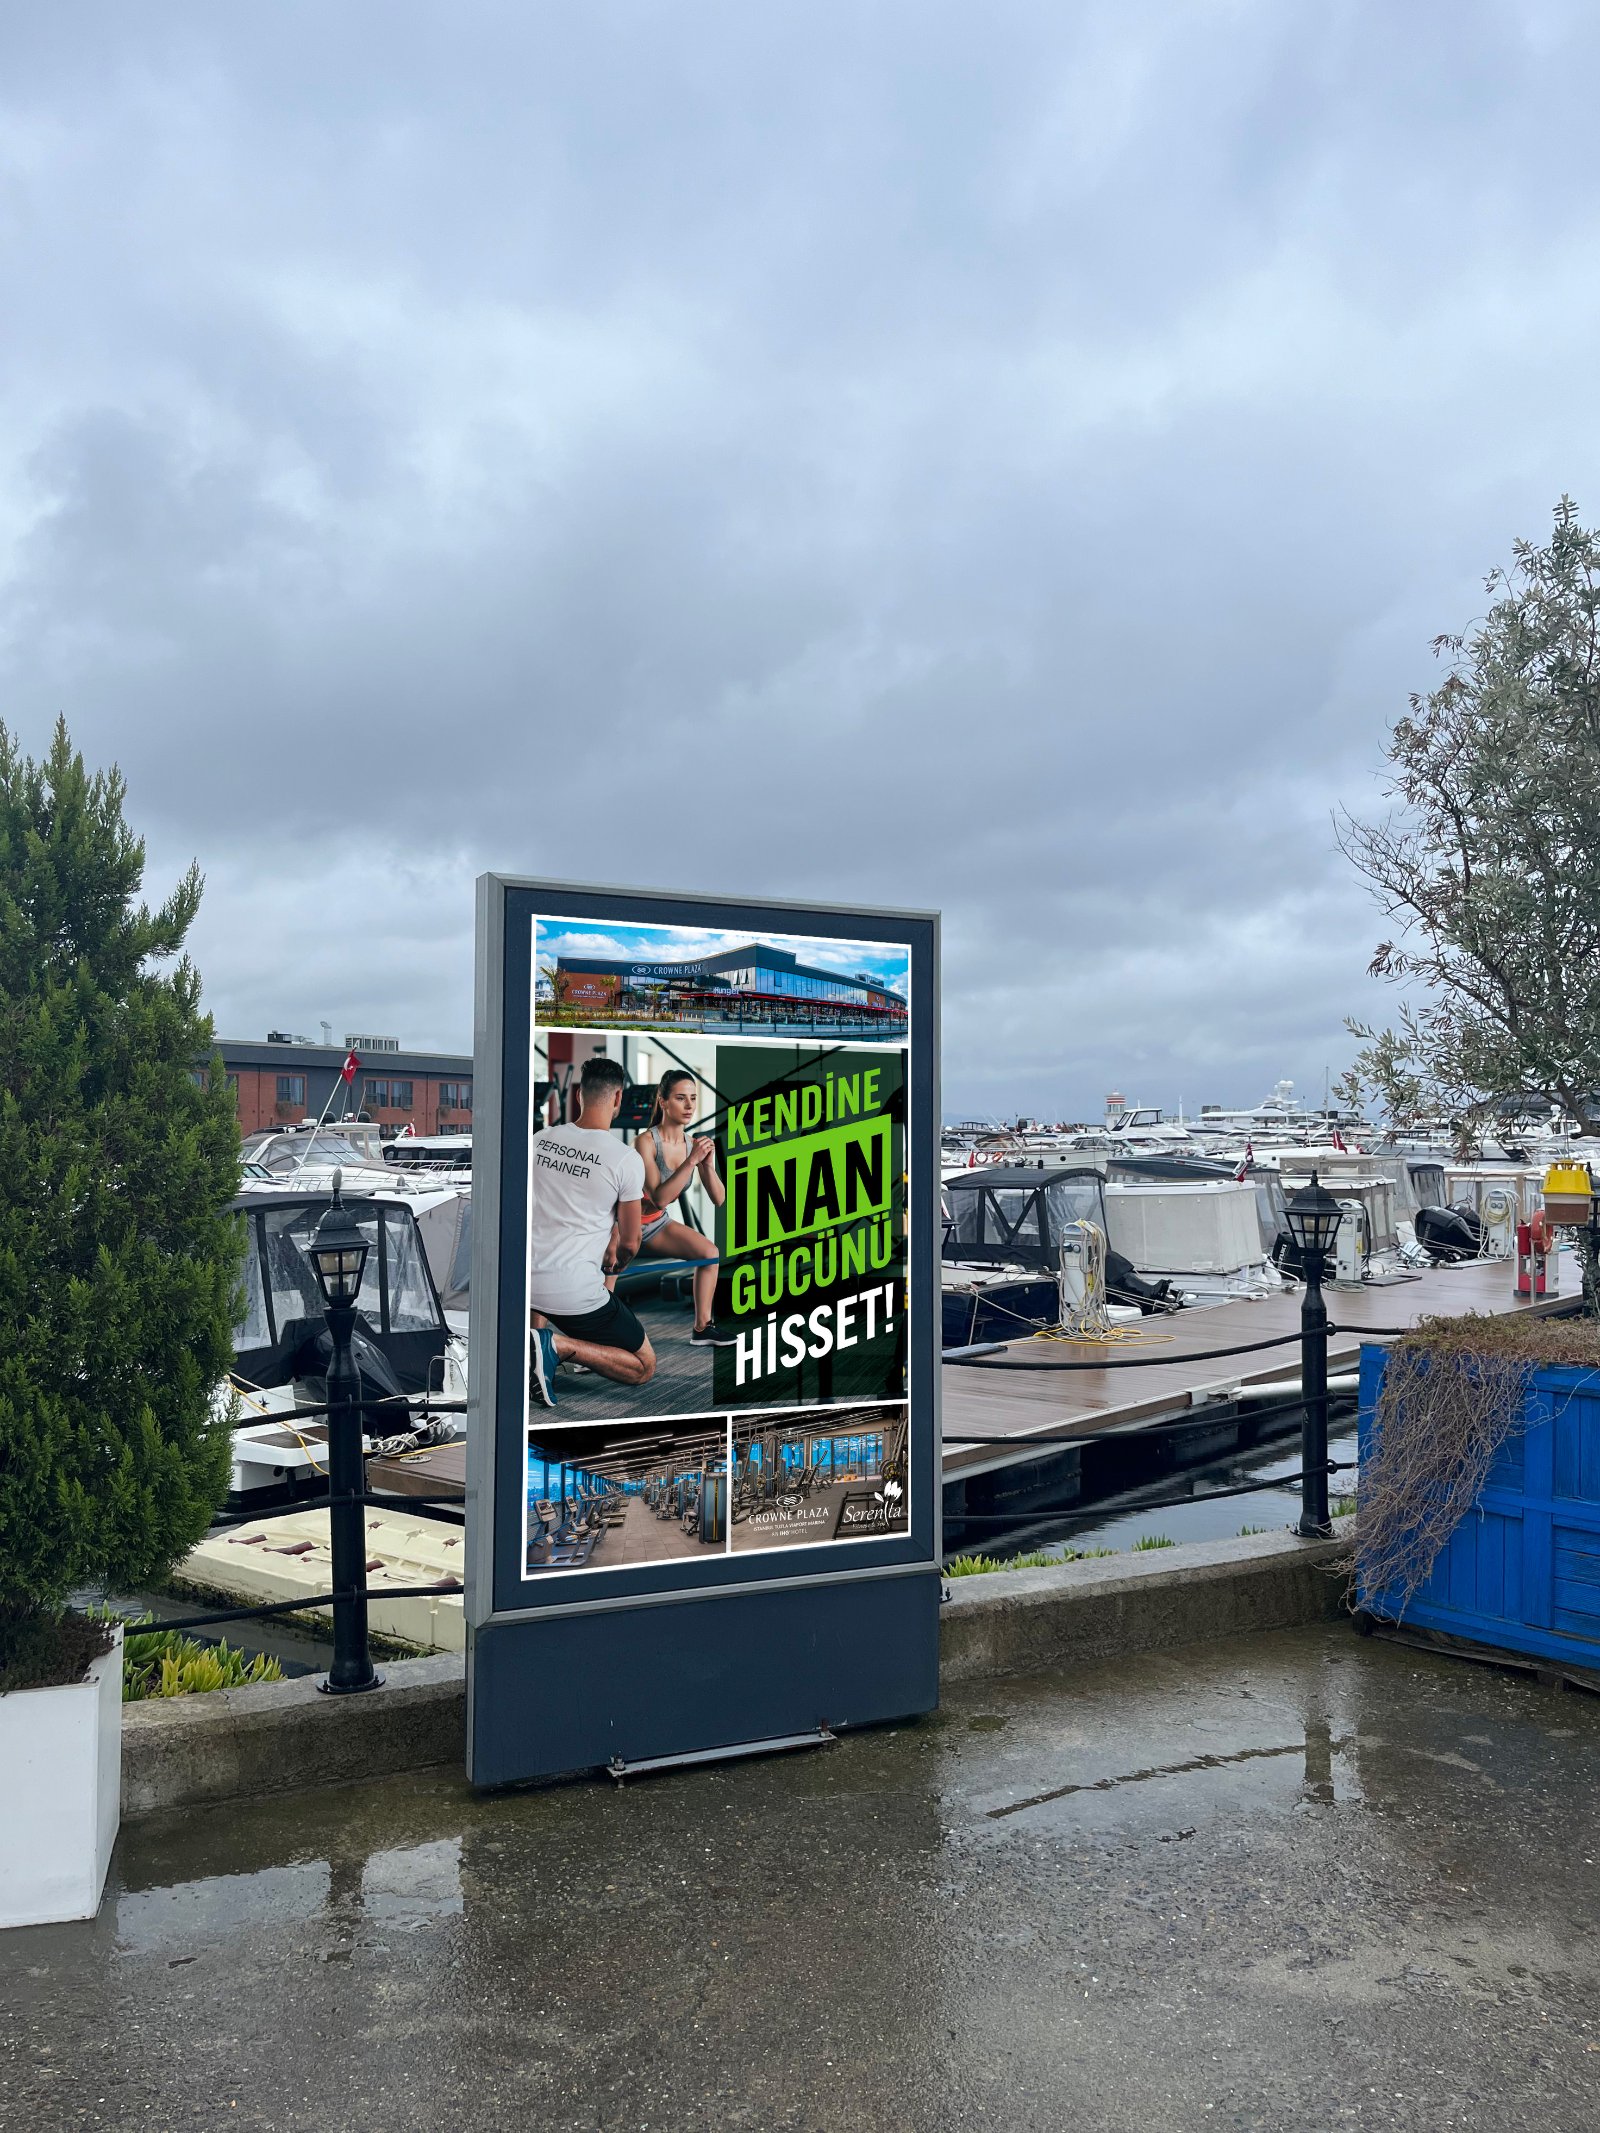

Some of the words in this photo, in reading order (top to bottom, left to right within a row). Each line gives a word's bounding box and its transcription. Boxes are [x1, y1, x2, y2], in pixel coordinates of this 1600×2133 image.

[653, 966, 682, 975] CROWNE
[684, 964, 702, 974] PLAZA
[727, 1067, 881, 1149] KENDİNE
[536, 1139, 602, 1166] PERSONAL
[536, 1153, 591, 1179] TRAINER
[734, 1131, 884, 1251] İNAN
[731, 1211, 892, 1316] GÜCÜNÜ
[735, 1282, 895, 1386] HİSSET!
[748, 1510, 793, 1525] CROWNE
[797, 1507, 829, 1520] PLAZA
